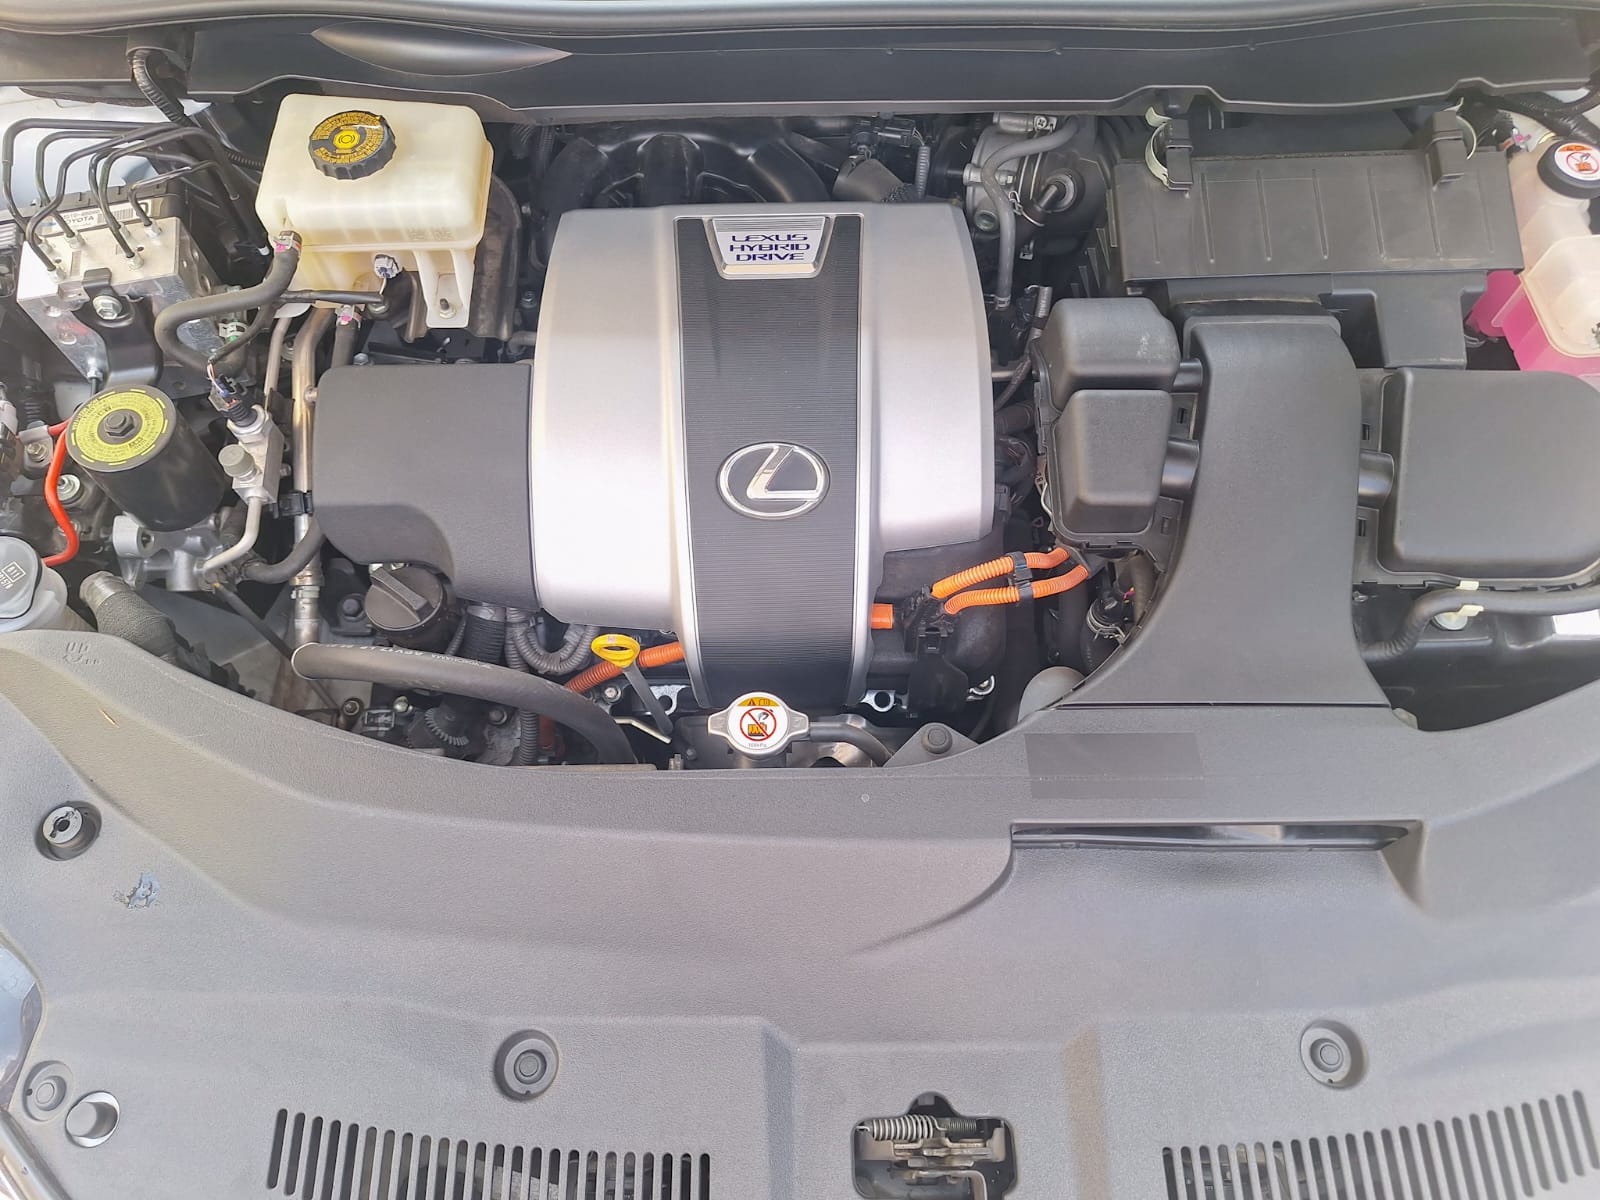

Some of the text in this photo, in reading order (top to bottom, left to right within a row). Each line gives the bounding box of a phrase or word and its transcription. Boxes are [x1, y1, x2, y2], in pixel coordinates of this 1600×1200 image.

[731, 233, 808, 242] LEXUS
[729, 243, 811, 252] HYBRID
[736, 252, 805, 261] DRIVE
